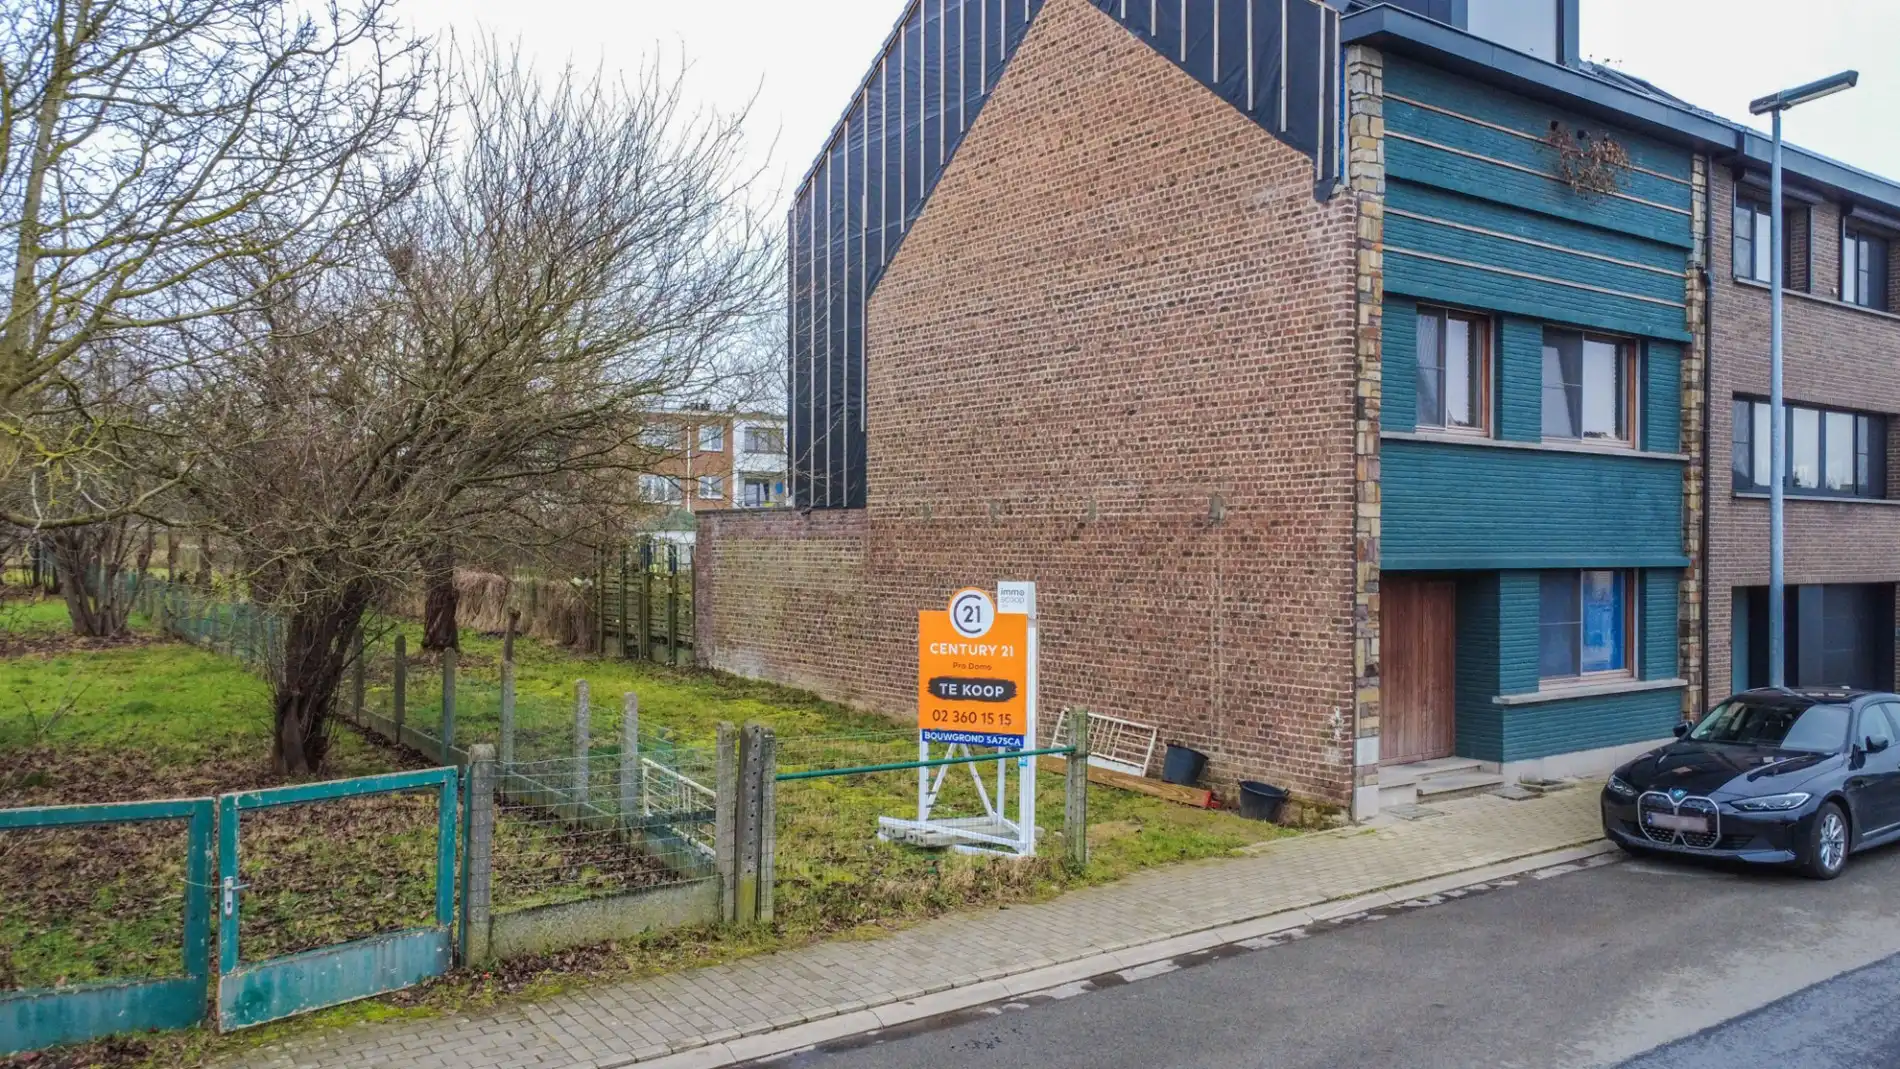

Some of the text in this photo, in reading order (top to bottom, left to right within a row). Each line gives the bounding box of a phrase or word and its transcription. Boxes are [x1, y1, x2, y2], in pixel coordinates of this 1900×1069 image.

[930, 643, 1014, 657] CENTURY 21
[952, 661, 967, 669] Pro
[939, 683, 1004, 697] TE KOOP
[932, 709, 1012, 726] 02 360 15 15
[924, 731, 985, 744] BOUWGROND
